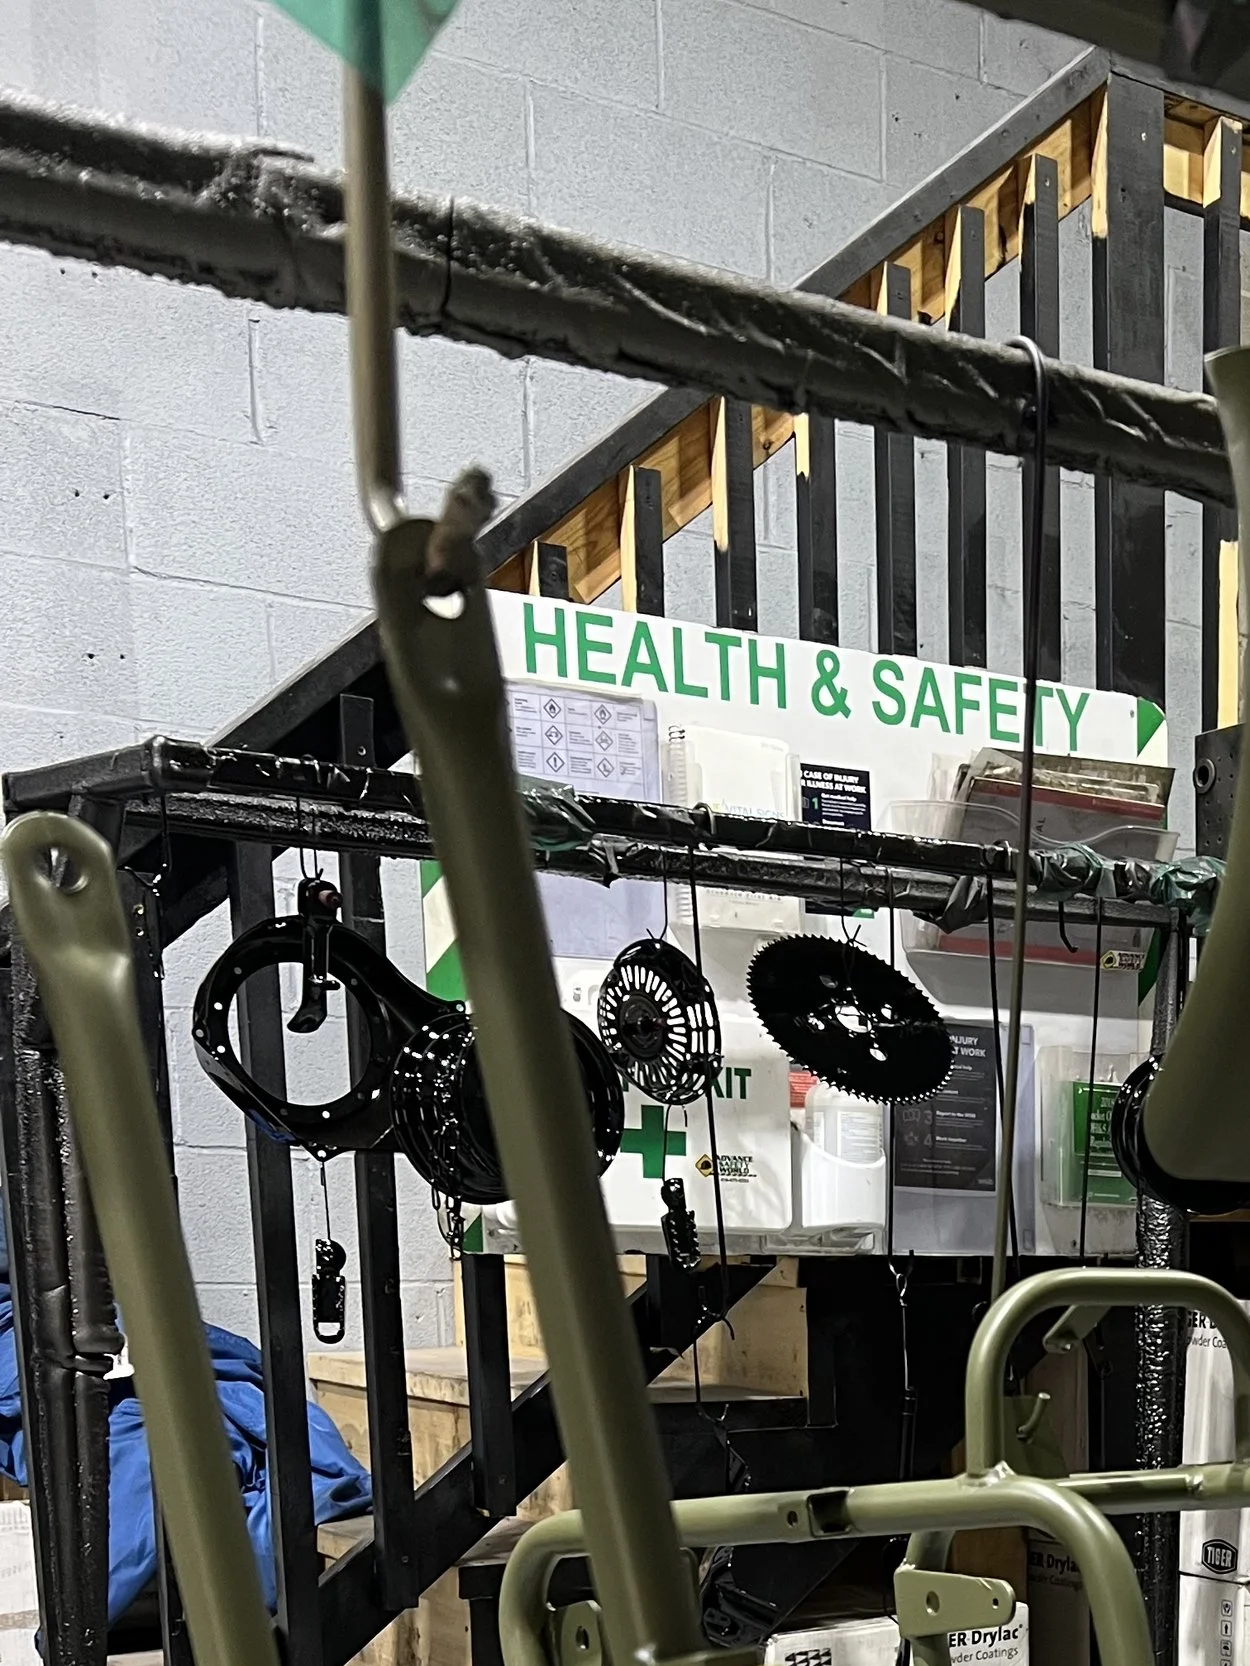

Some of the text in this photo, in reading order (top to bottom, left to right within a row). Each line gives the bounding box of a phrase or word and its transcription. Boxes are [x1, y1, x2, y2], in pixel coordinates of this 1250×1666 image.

[523, 603, 1091, 751] HEALTH & SAFETY
[844, 784, 867, 794] WORK
[960, 1048, 986, 1057] WORK
[1206, 1546, 1232, 1568] TIGER
[976, 1647, 1019, 1660] Coatings
